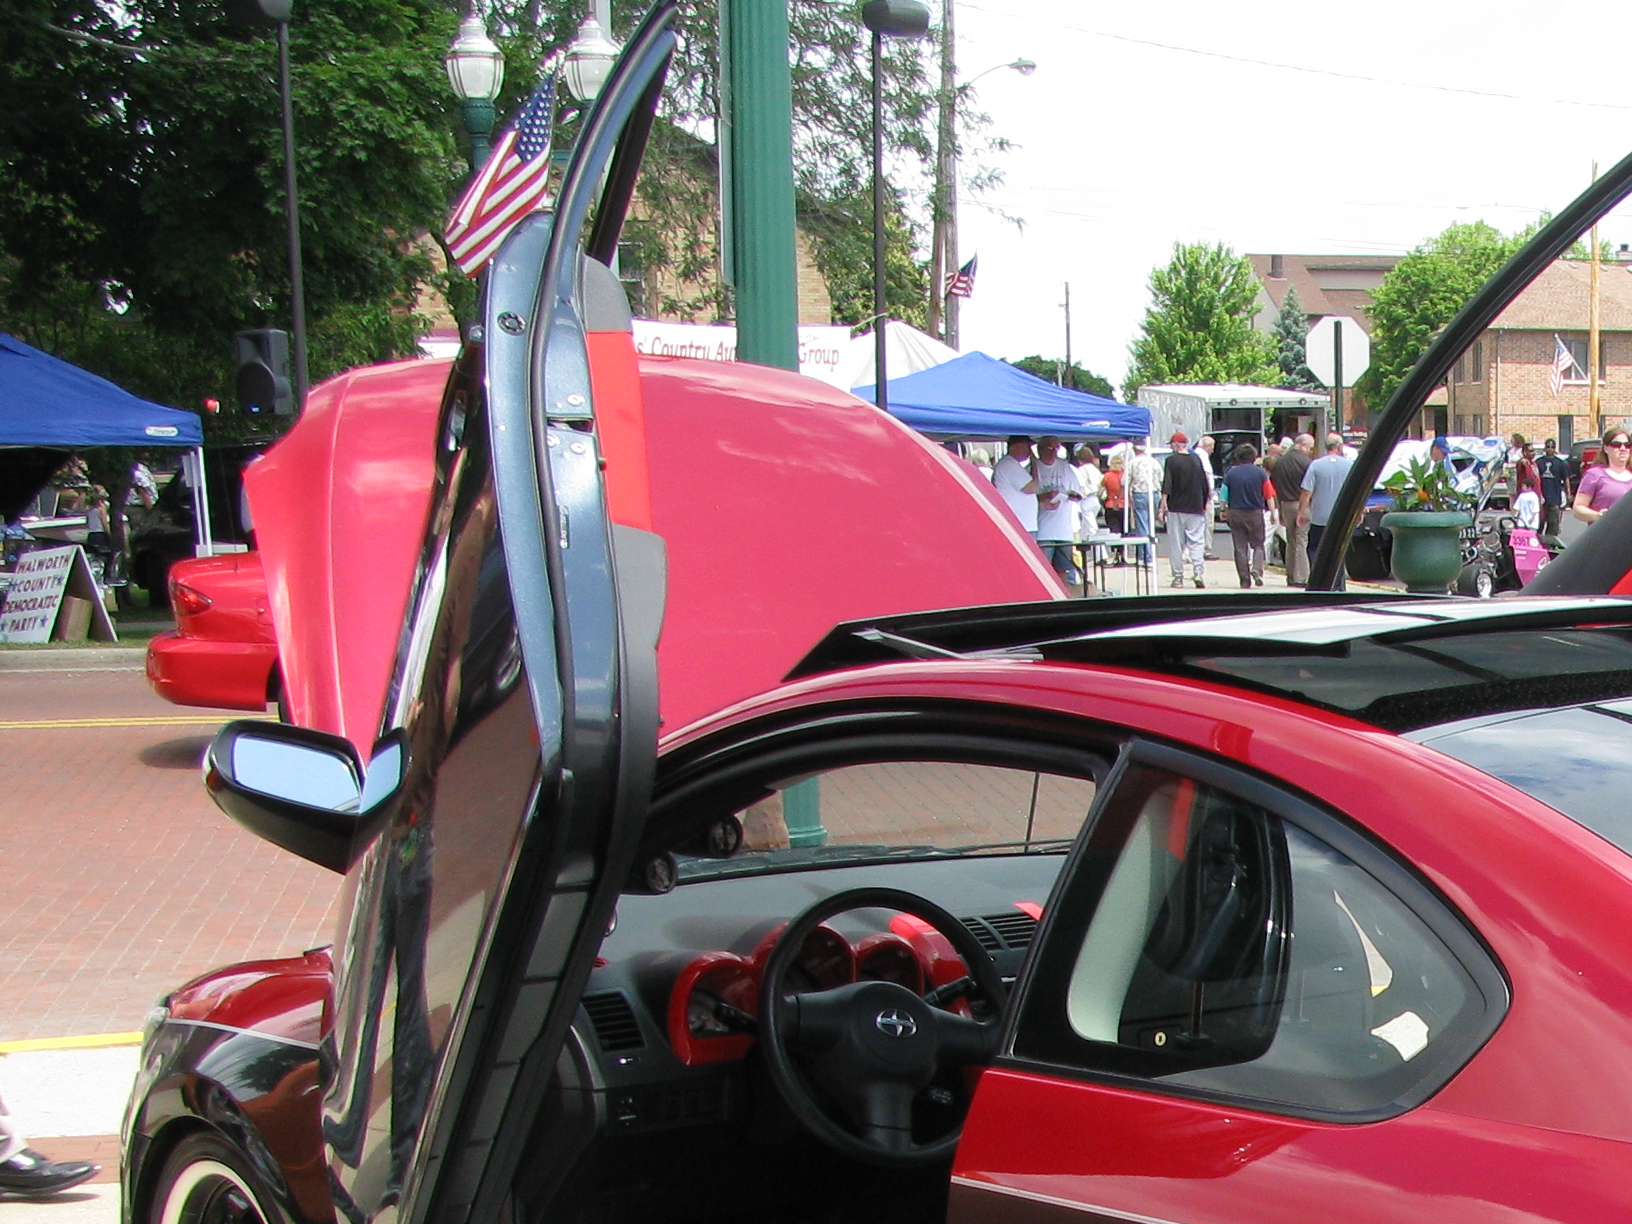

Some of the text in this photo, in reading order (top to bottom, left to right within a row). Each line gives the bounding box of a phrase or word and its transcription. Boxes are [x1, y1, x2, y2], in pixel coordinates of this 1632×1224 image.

[15, 554, 70, 574] WALWORTH
[17, 575, 59, 593] COUNTY
[2, 594, 59, 613] DEMOCRATIC
[9, 616, 38, 632] PARTY
